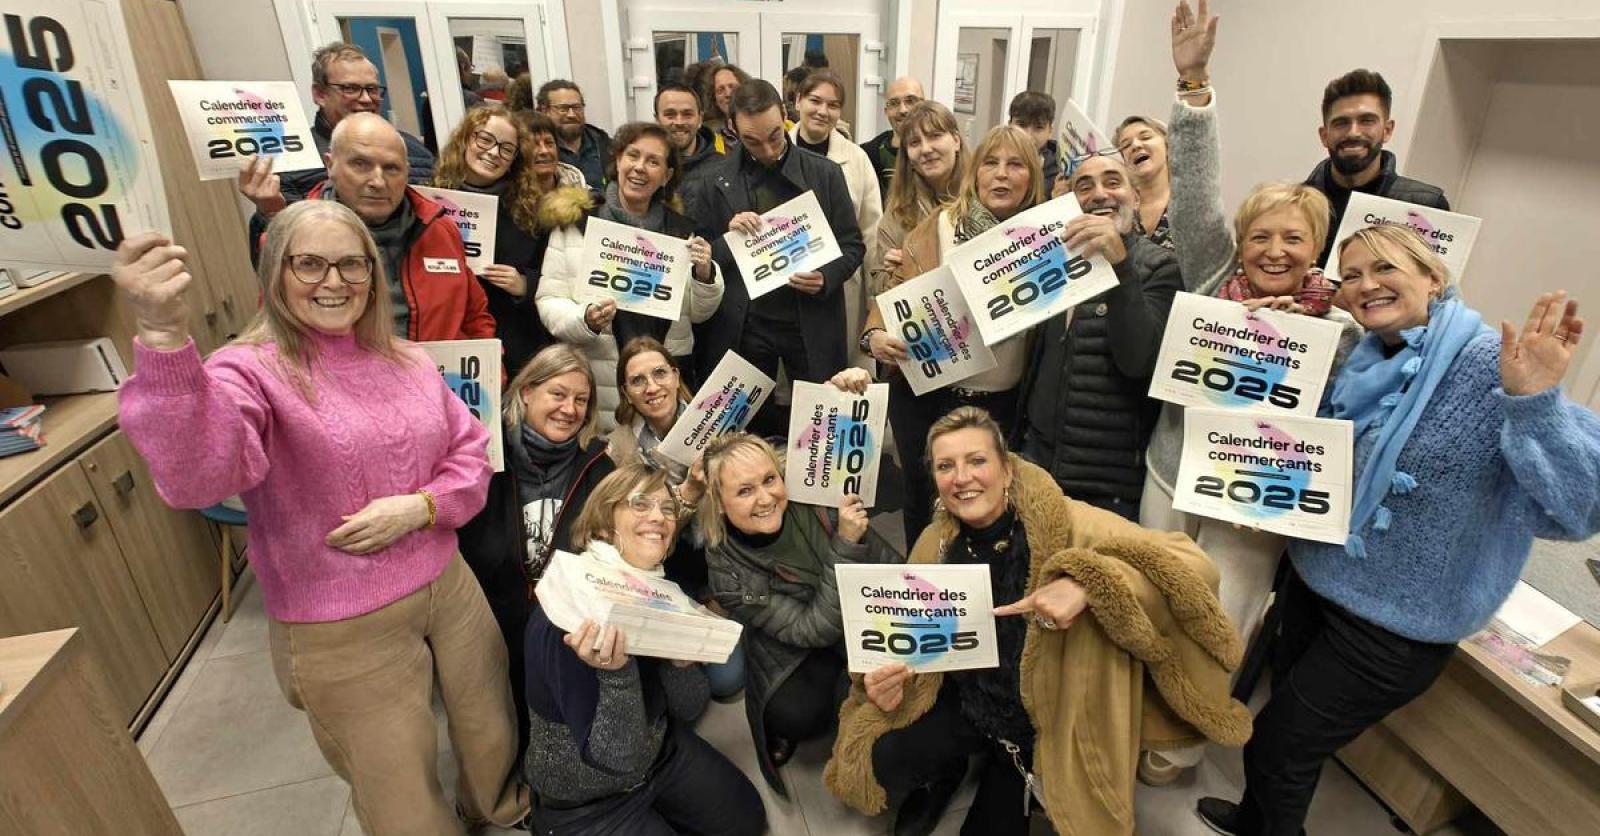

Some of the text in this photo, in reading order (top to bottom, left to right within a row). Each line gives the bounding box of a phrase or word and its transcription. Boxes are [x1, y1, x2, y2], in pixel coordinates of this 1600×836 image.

[200, 100, 285, 111] Calendrier des
[207, 114, 289, 126] commerçants
[4, 13, 125, 251] 2025
[208, 135, 304, 159] 2025
[459, 208, 480, 219] des
[744, 212, 809, 249] Calendrier des
[600, 237, 675, 263] Calendrier des
[750, 222, 812, 258] commerçants
[973, 220, 1065, 272] Calendrier des
[1430, 228, 1454, 242] des
[599, 250, 672, 274] commerçants
[753, 236, 825, 281] 2025
[982, 235, 1062, 285] commerçant
[588, 269, 673, 301] 2025
[987, 254, 1093, 321] 2025
[894, 299, 943, 379] 2025
[921, 295, 959, 364] commerçants
[933, 288, 972, 361] Calendrier des
[1192, 316, 1309, 354] Calendrier des
[1189, 336, 1301, 370] commerçants
[1171, 359, 1302, 409] 2025
[683, 375, 738, 447] Calendrier des
[803, 403, 824, 487] Calendrier des
[820, 406, 840, 488] commerçants
[843, 399, 870, 496] 2025
[1207, 431, 1325, 456] Calendrier des
[1208, 449, 1323, 473] commerçants
[1194, 475, 1330, 515] 2025
[860, 586, 967, 601] Calendrier des
[864, 604, 968, 622] commerçants
[861, 629, 980, 656] 2025
